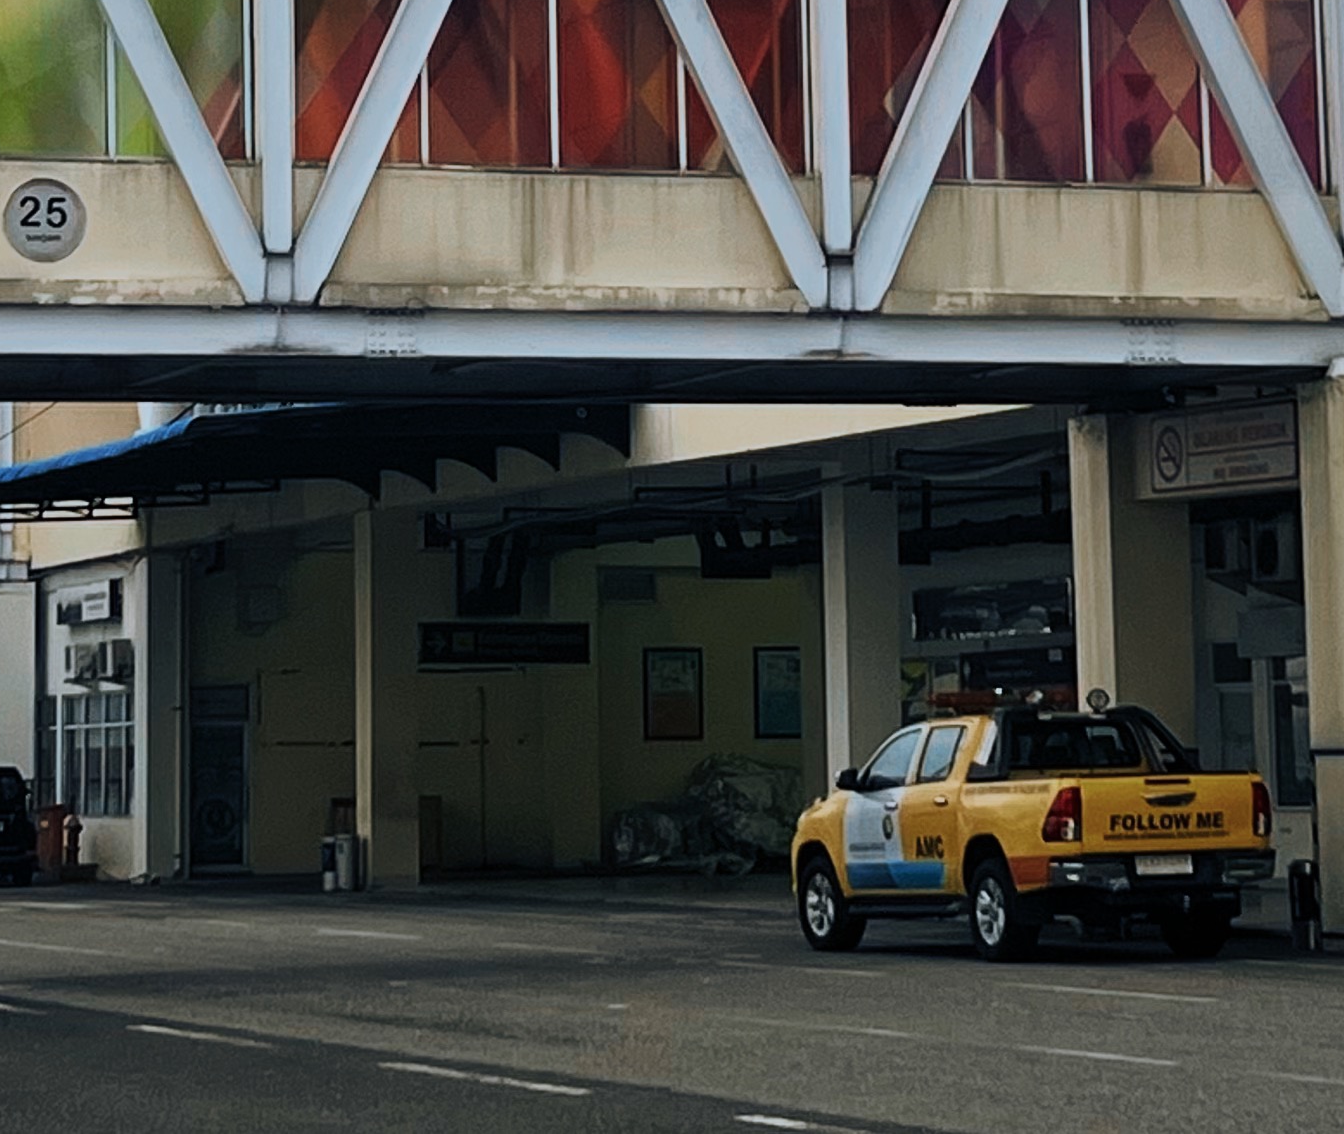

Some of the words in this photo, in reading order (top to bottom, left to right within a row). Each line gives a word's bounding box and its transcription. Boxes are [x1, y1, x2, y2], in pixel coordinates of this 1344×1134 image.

[19, 195, 68, 229] 25
[1110, 812, 1191, 832] FOLLOW
[1196, 811, 1224, 828] ME
[915, 834, 945, 859] AMC
